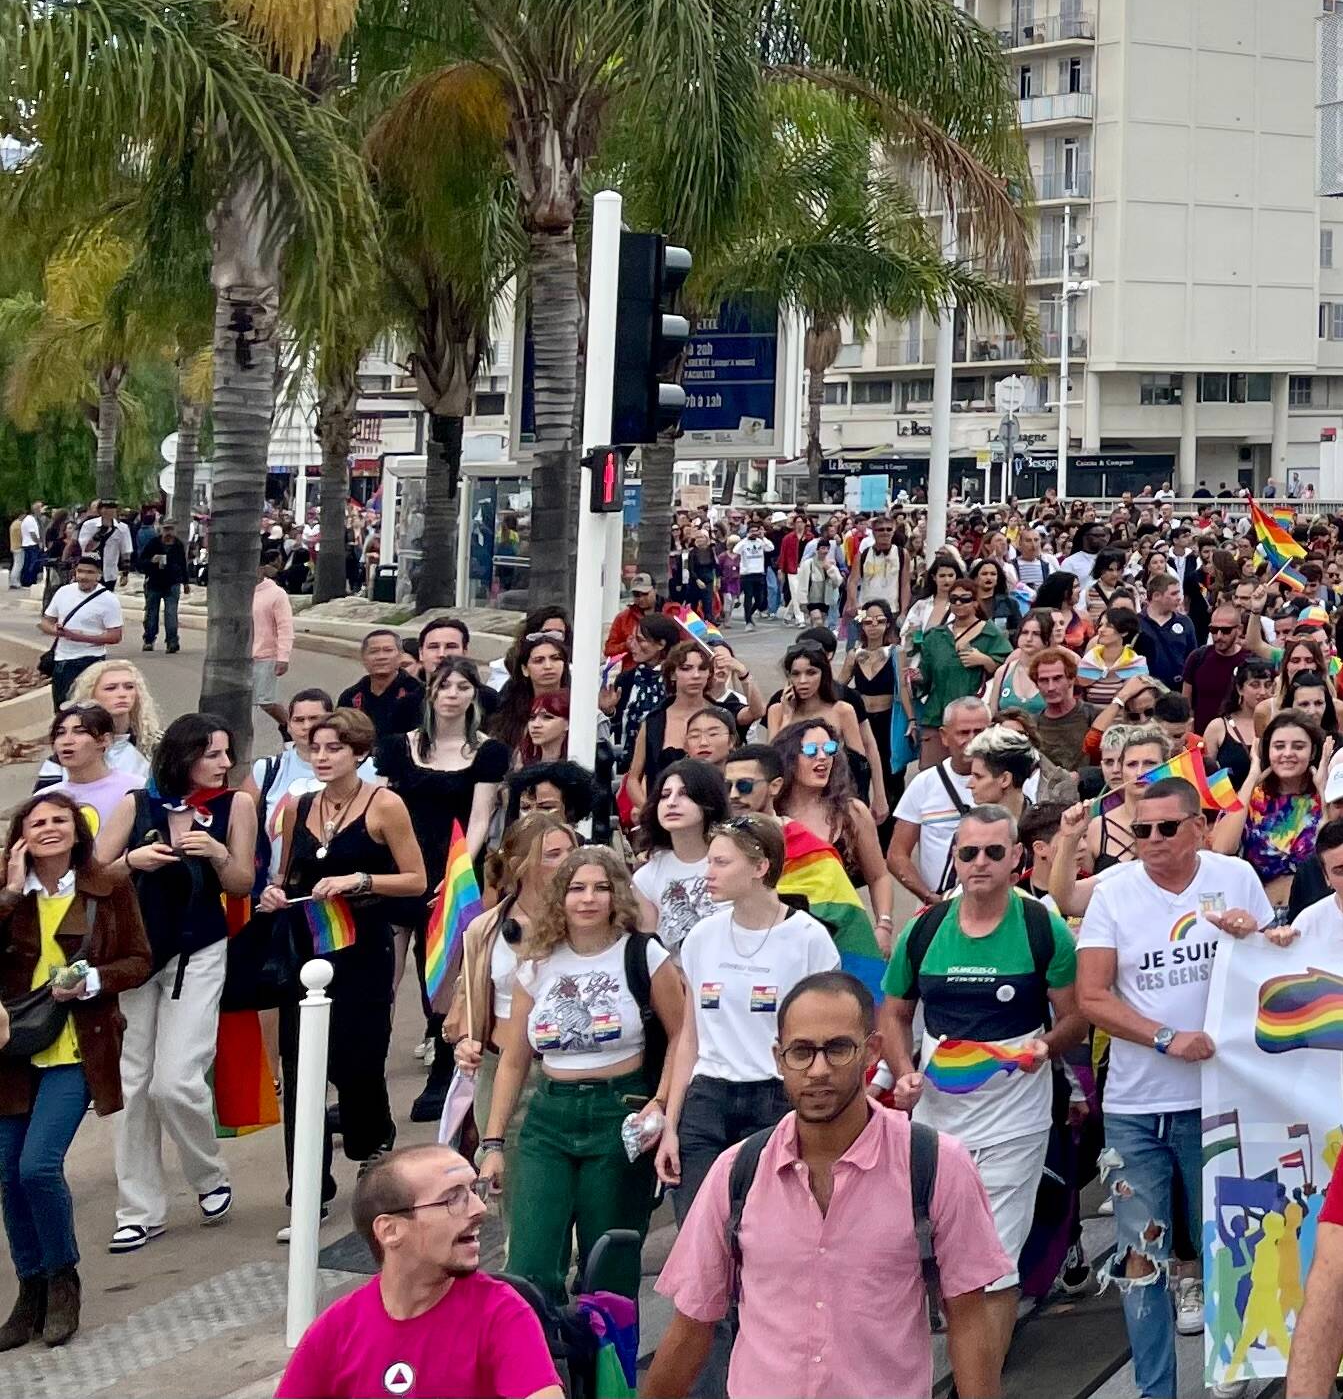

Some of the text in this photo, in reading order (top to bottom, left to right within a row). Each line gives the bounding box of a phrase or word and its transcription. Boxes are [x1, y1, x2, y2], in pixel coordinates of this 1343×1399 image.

[896, 420, 932, 437] Le Besa
[1139, 951, 1165, 970] JE
[1168, 963, 1209, 986] GENS
